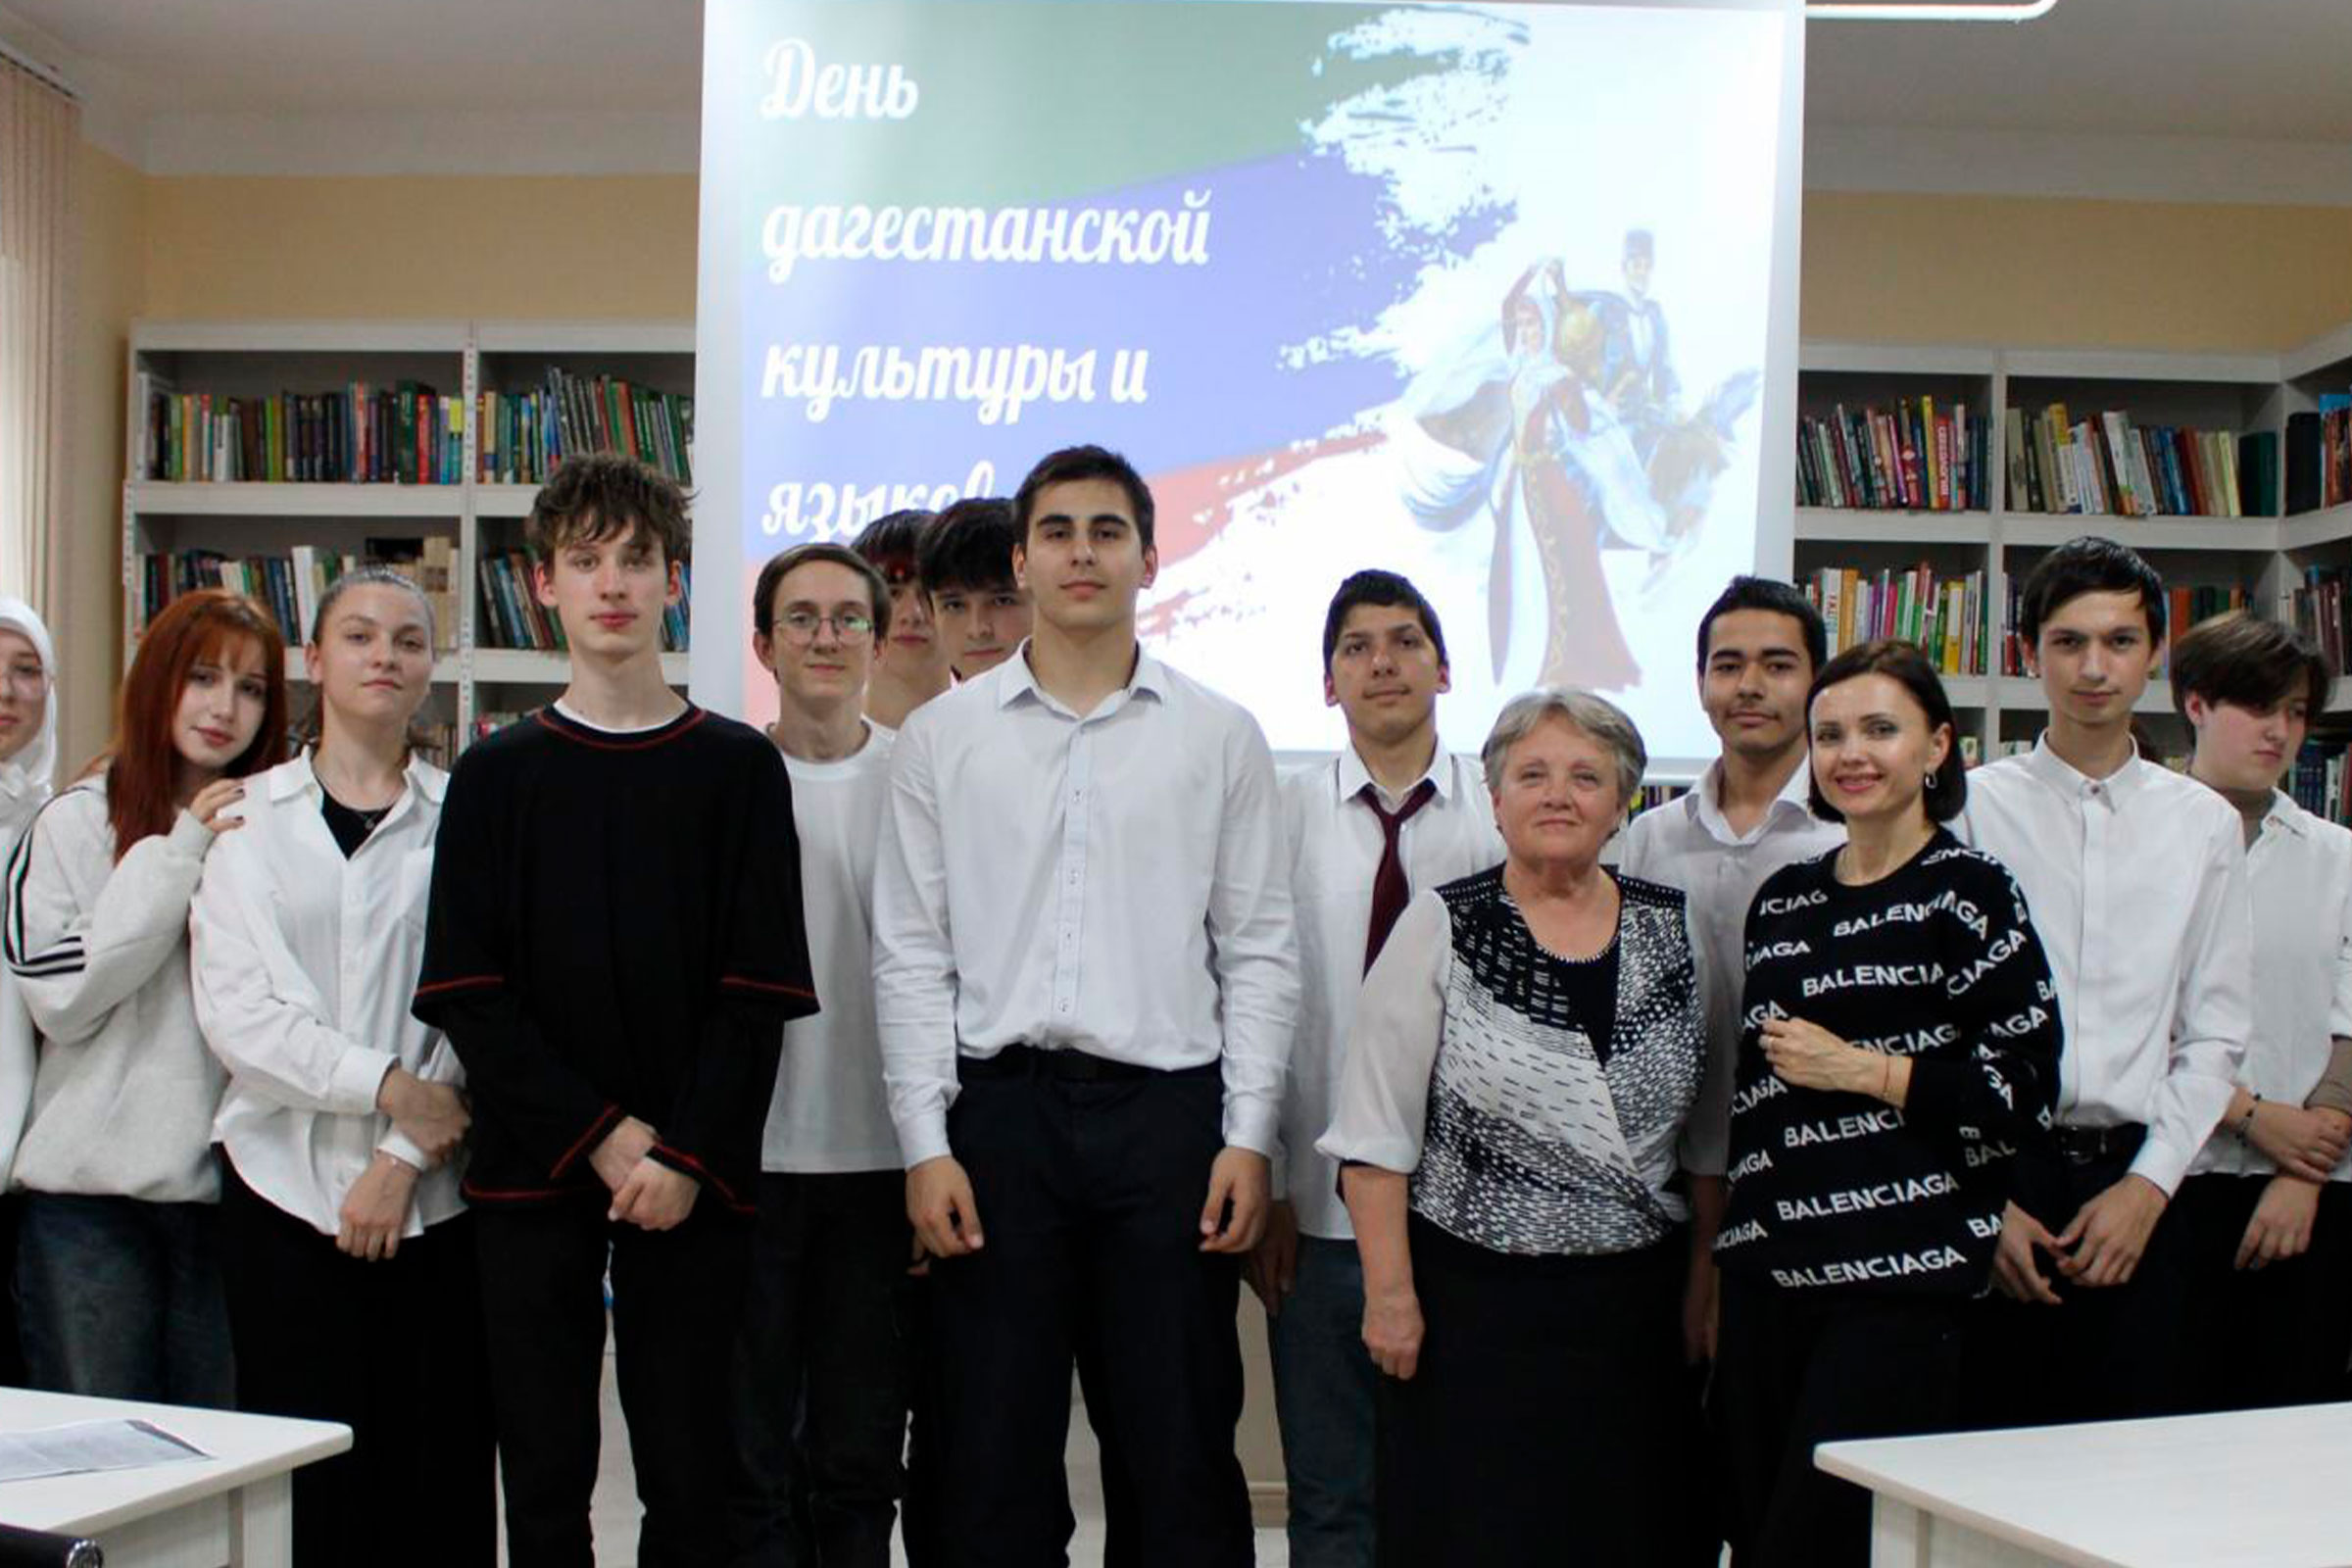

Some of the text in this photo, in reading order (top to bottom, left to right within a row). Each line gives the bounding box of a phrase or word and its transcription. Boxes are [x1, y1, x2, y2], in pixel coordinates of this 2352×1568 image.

[760, 38, 919, 119] День
[761, 188, 1211, 283] дагестанской
[760, 344, 1149, 424] культуры и
[1853, 1022, 1963, 1056] NCIAG
[1776, 1170, 1961, 1222] BALENCIAGA
[1770, 1245, 1969, 1289] BALENCIAGA
